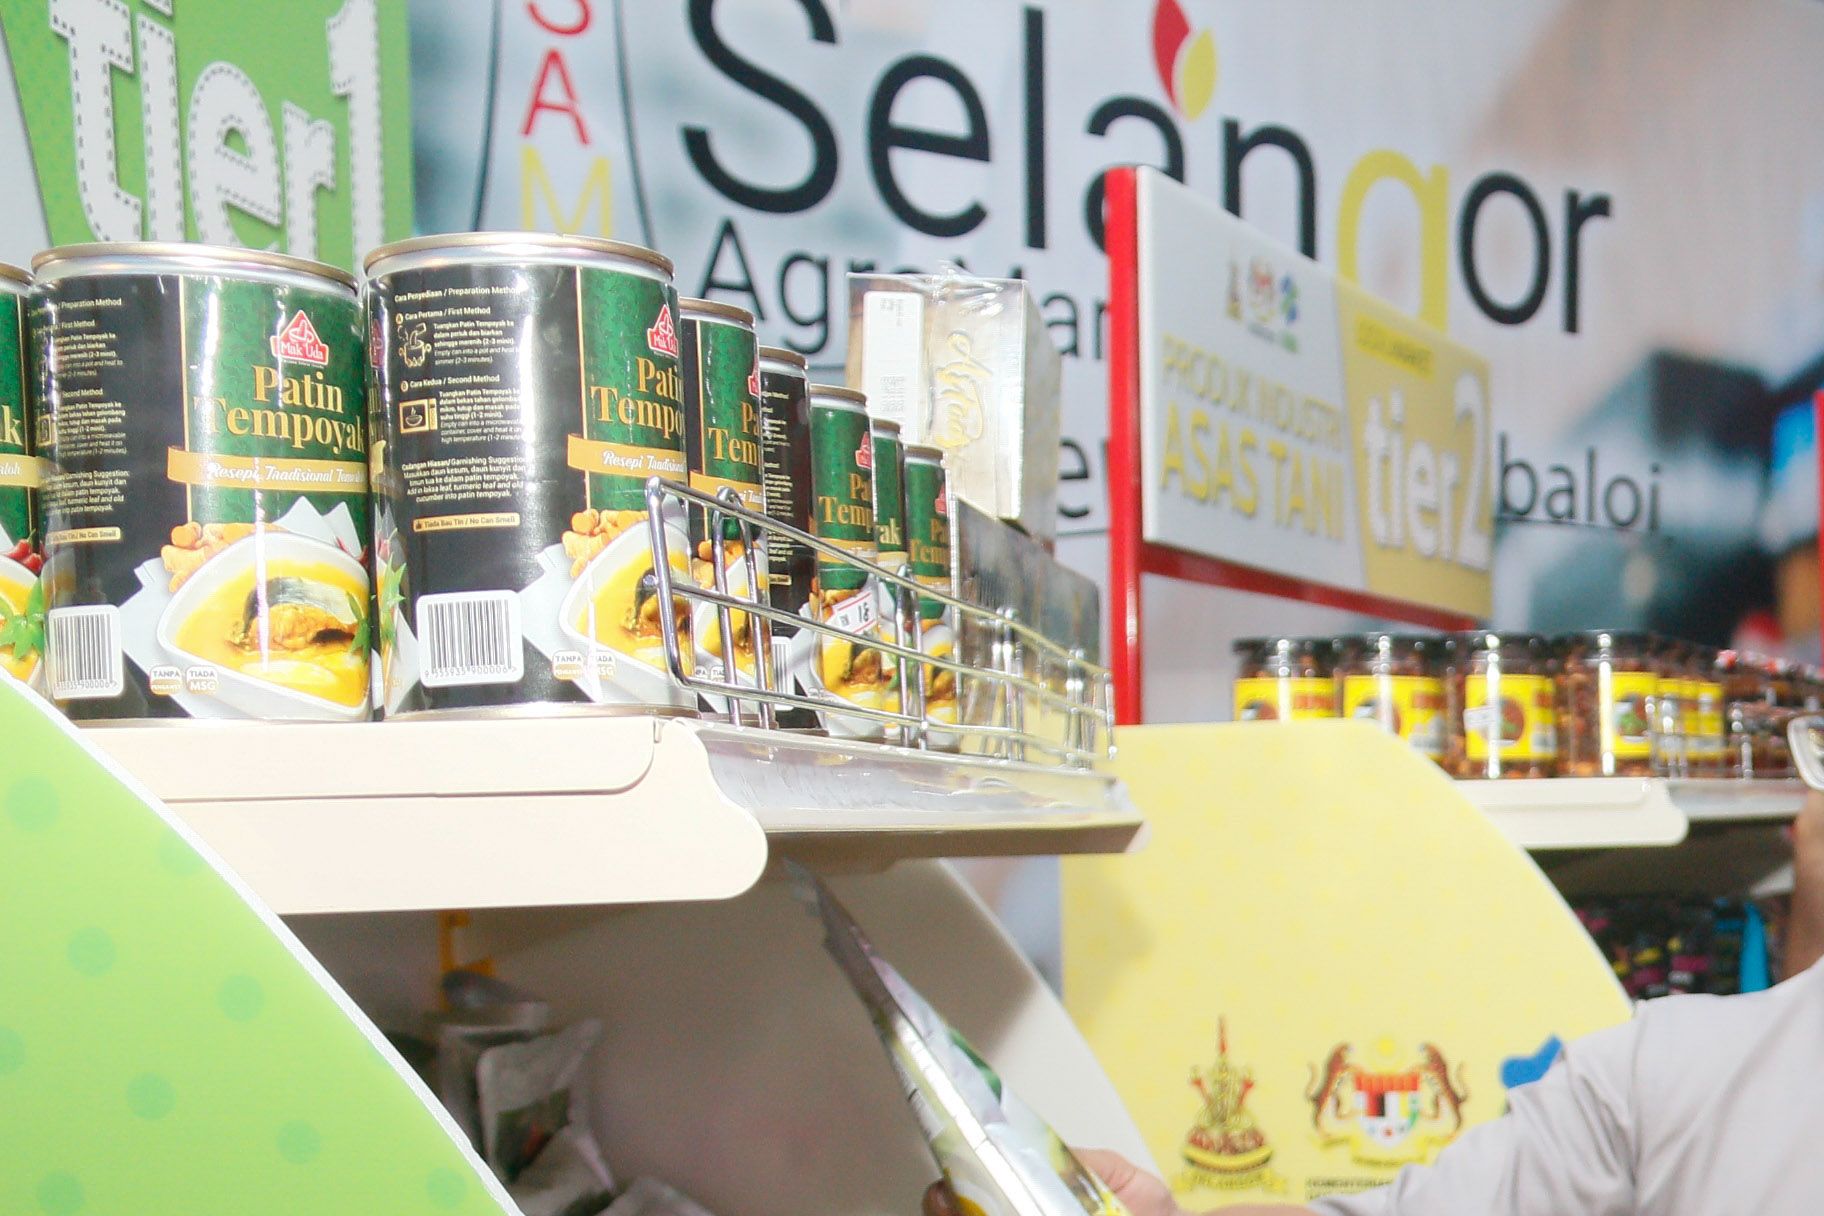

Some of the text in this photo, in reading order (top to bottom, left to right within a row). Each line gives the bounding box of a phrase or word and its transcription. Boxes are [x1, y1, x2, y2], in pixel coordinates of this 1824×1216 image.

[50, 0, 386, 280] tier1
[681, 0, 1614, 334] Selangor
[448, 287, 490, 296] Preparation
[95, 298, 122, 306] Method
[464, 307, 491, 315] Method
[281, 342, 324, 361] Mak Uda
[447, 376, 472, 384] Second
[473, 375, 500, 383] Method
[252, 365, 344, 414] Patin
[590, 386, 685, 439] Tempo
[602, 450, 644, 469] Resepi
[1159, 401, 1258, 519] ASAS
[1267, 438, 1346, 542] TANI
[1363, 371, 1492, 573] tier2
[480, 517, 494, 525] Can
[189, 680, 217, 692] MSG
